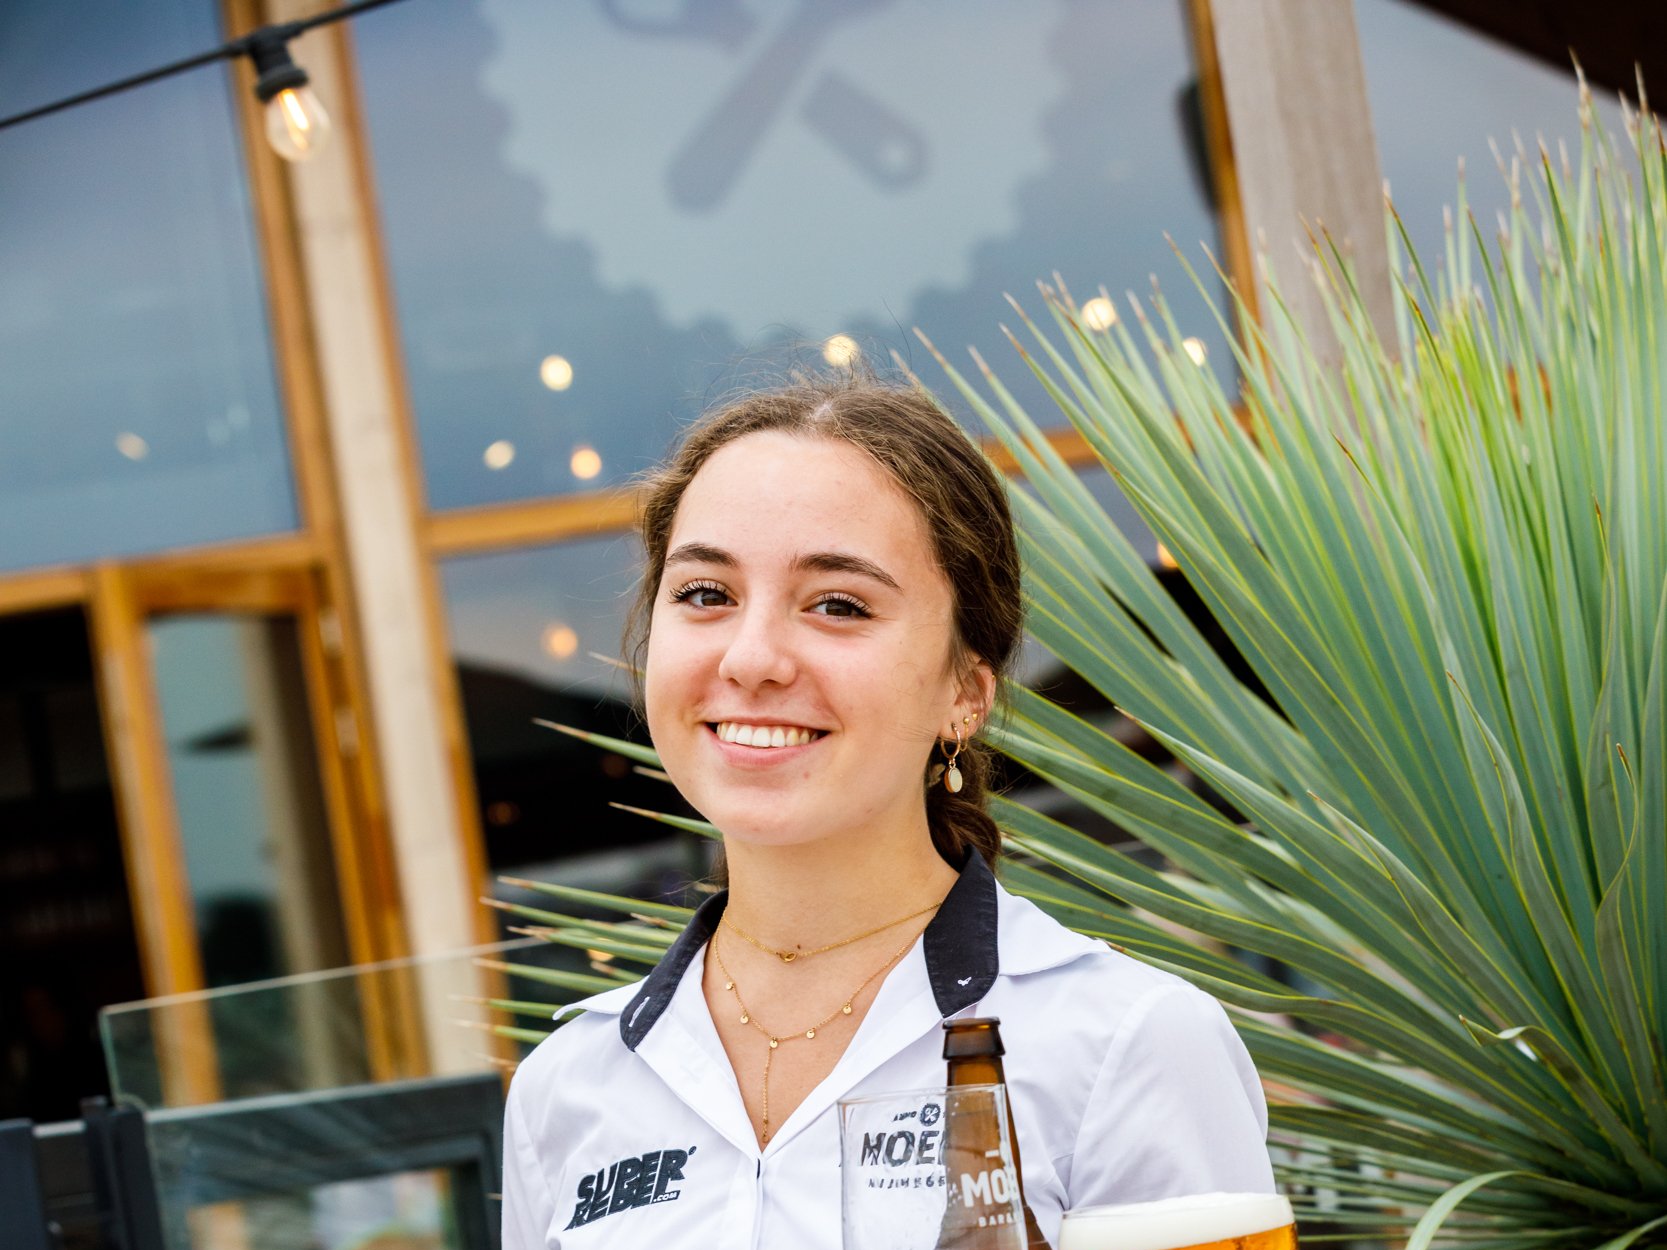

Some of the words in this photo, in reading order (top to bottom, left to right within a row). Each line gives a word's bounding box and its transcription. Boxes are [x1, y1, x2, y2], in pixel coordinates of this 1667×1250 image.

[861, 1130, 946, 1167] MOE
[577, 1149, 688, 1201] SUPER
[868, 1174, 945, 1189] NIJMEGE
[563, 1173, 678, 1231] REBEL
